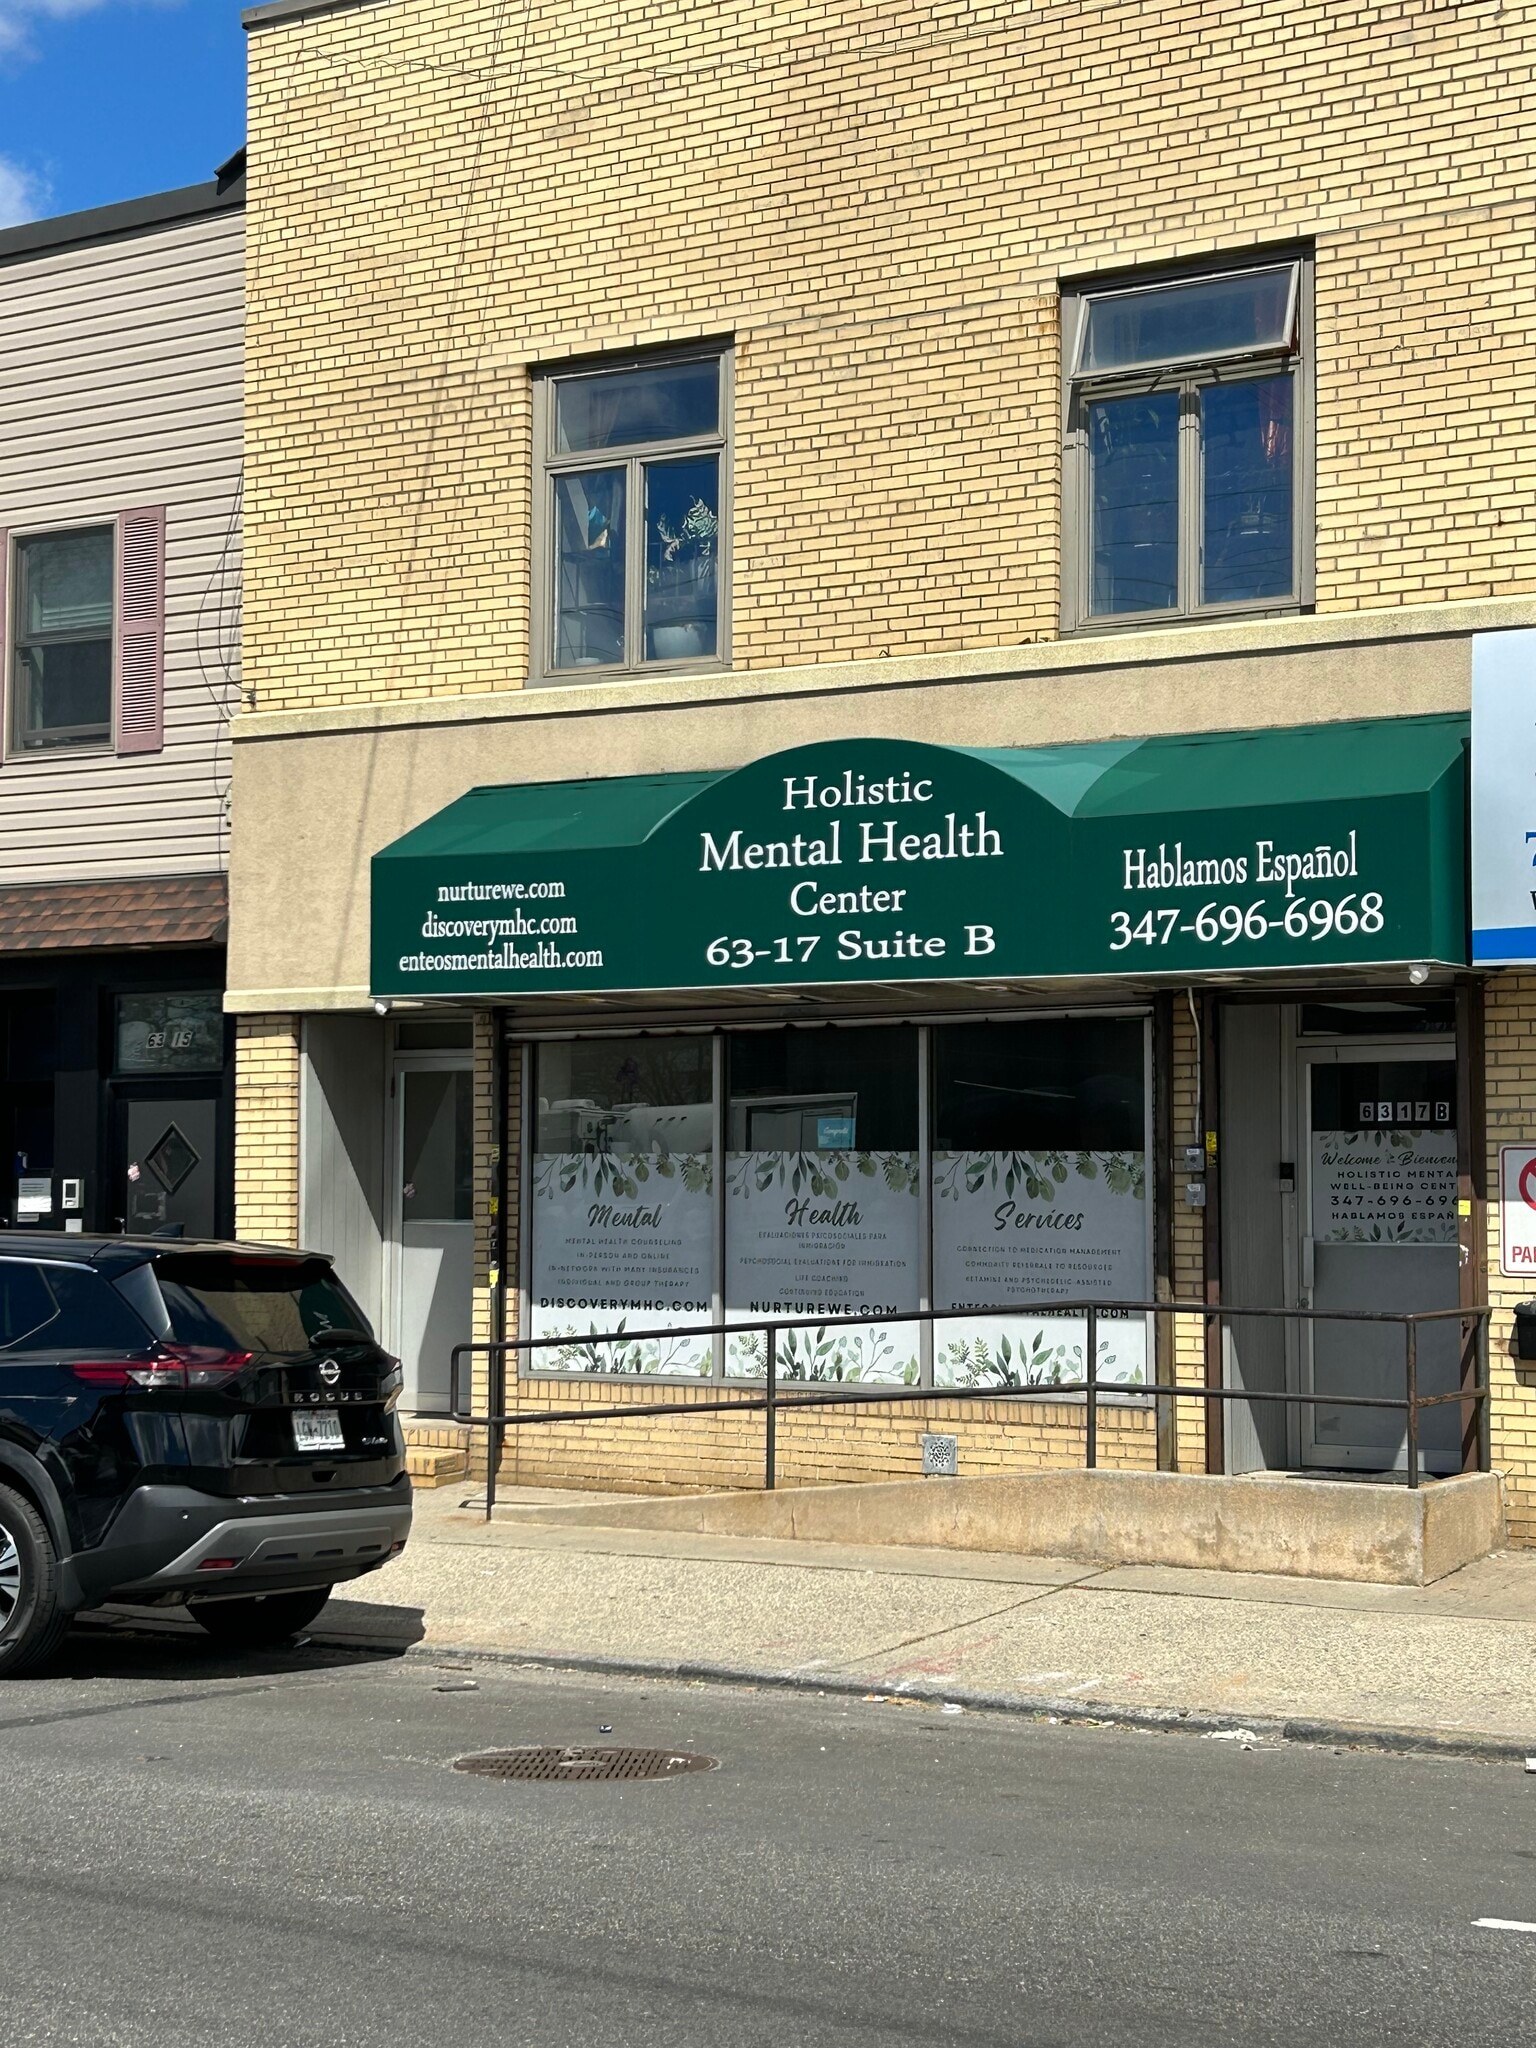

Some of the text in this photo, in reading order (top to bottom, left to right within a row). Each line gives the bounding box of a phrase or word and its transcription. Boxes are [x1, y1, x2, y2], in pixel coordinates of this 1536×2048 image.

[782, 769, 933, 810] Holistic
[699, 810, 1004, 872] Mental Health
[1123, 829, 1359, 898] Hablamos Español
[437, 878, 566, 903] nurturewe.com
[790, 881, 907, 916] Center
[421, 907, 578, 947] discoverymhc.com
[1109, 891, 1385, 951] 347-696-6968
[399, 940, 604, 973] enteosmentalhealth.com
[706, 924, 996, 969] 63-17 Suite B
[148, 1032, 191, 1047] 63 15
[1320, 1152, 1381, 1166] Welcome
[1330, 1182, 1414, 1190] WELL-BEING
[1337, 1170, 1401, 1179] HOLISTIC
[587, 1203, 663, 1229] Mental
[784, 1197, 864, 1228] Health
[993, 1200, 1085, 1231] Services
[1331, 1212, 1405, 1220] HABLAMOS
[540, 1297, 708, 1312] DISCOVERYMHC.COM
[749, 1301, 898, 1316] NURTUREWE.COM
[293, 1392, 362, 1402] ROGUE
